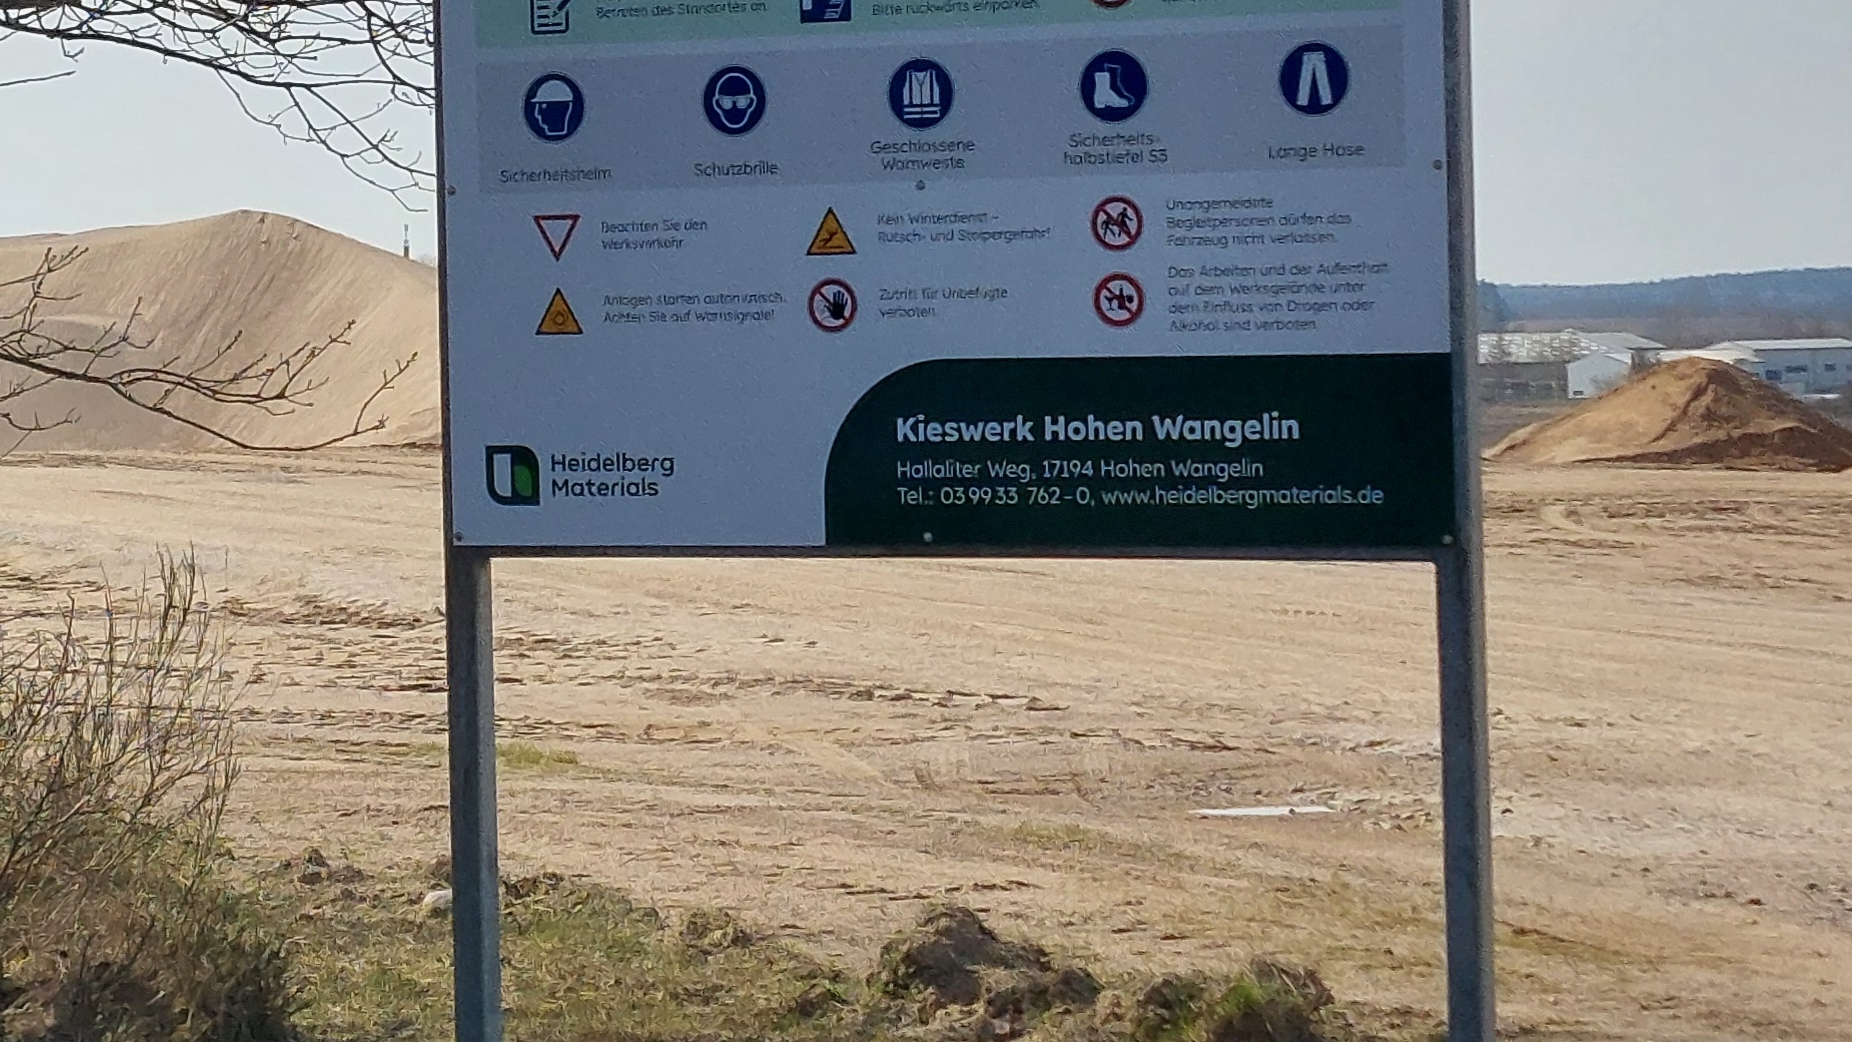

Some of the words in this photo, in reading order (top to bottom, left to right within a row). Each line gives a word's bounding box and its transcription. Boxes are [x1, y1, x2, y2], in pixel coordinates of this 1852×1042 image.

[870, 138, 976, 155] Geschlossene
[1268, 144, 1317, 162] Lange
[1323, 142, 1365, 157] Hose
[693, 161, 780, 178] Schutzbrille
[881, 155, 966, 171] Warnweste
[499, 166, 612, 184] Sicherheitshelm
[601, 220, 658, 234] Beachten
[663, 218, 680, 232] Sie
[930, 229, 954, 242] und
[896, 414, 1034, 442] Kieswerk
[1045, 414, 1143, 442] Hohen
[1151, 410, 1300, 448] Wangelin
[551, 451, 675, 477] Heidelberg
[987, 458, 1036, 482] Weg,
[1042, 460, 1094, 478] 17194
[1101, 458, 1165, 478] Hohen
[1171, 458, 1263, 483] Wangelin
[552, 475, 659, 498] Materials
[897, 487, 935, 505] Tel.:
[1102, 484, 1384, 509] www.heidelbergmaterials.de
